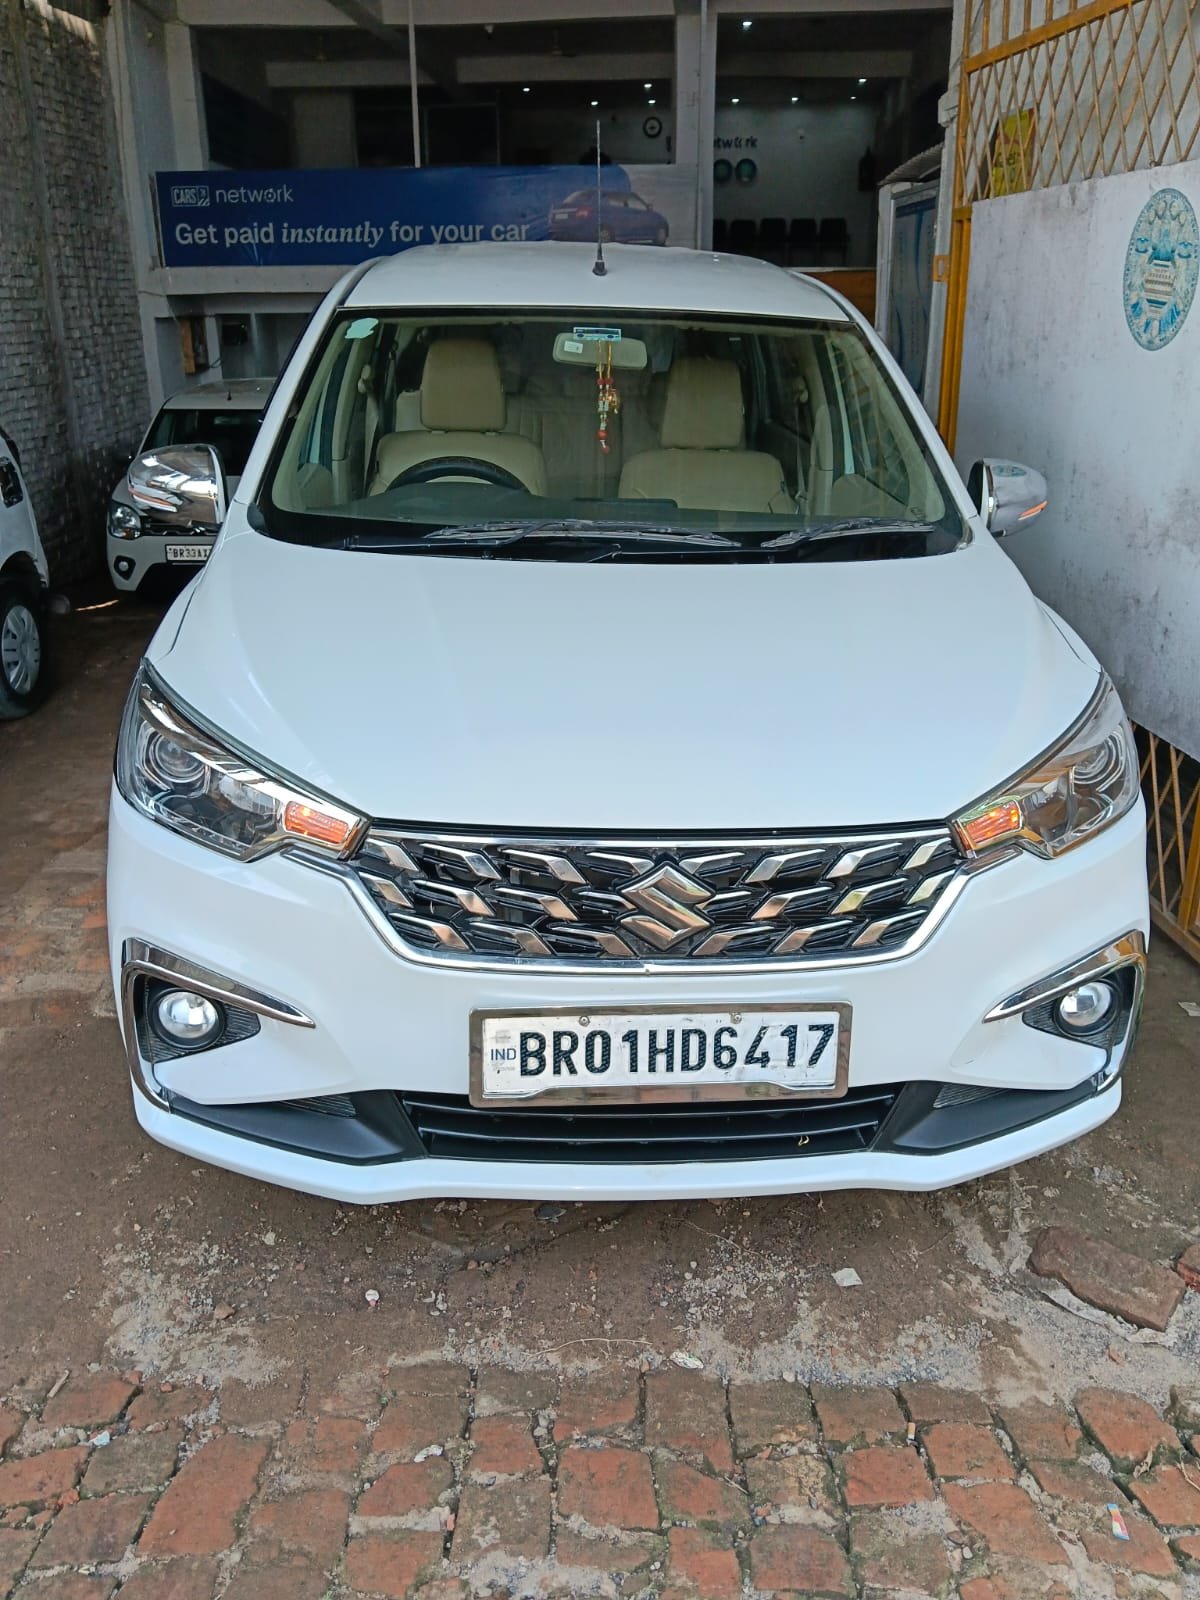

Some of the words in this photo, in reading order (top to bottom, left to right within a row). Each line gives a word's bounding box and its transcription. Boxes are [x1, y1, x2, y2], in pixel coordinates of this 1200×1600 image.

[215, 184, 294, 203] network
[175, 223, 218, 245] Get
[224, 222, 275, 248] paid
[281, 221, 384, 248] instantly
[390, 221, 423, 242] for
[431, 224, 482, 245] your
[491, 223, 530, 242] car
[490, 1048, 517, 1061] IND
[519, 1023, 835, 1077] BR01HD6417
